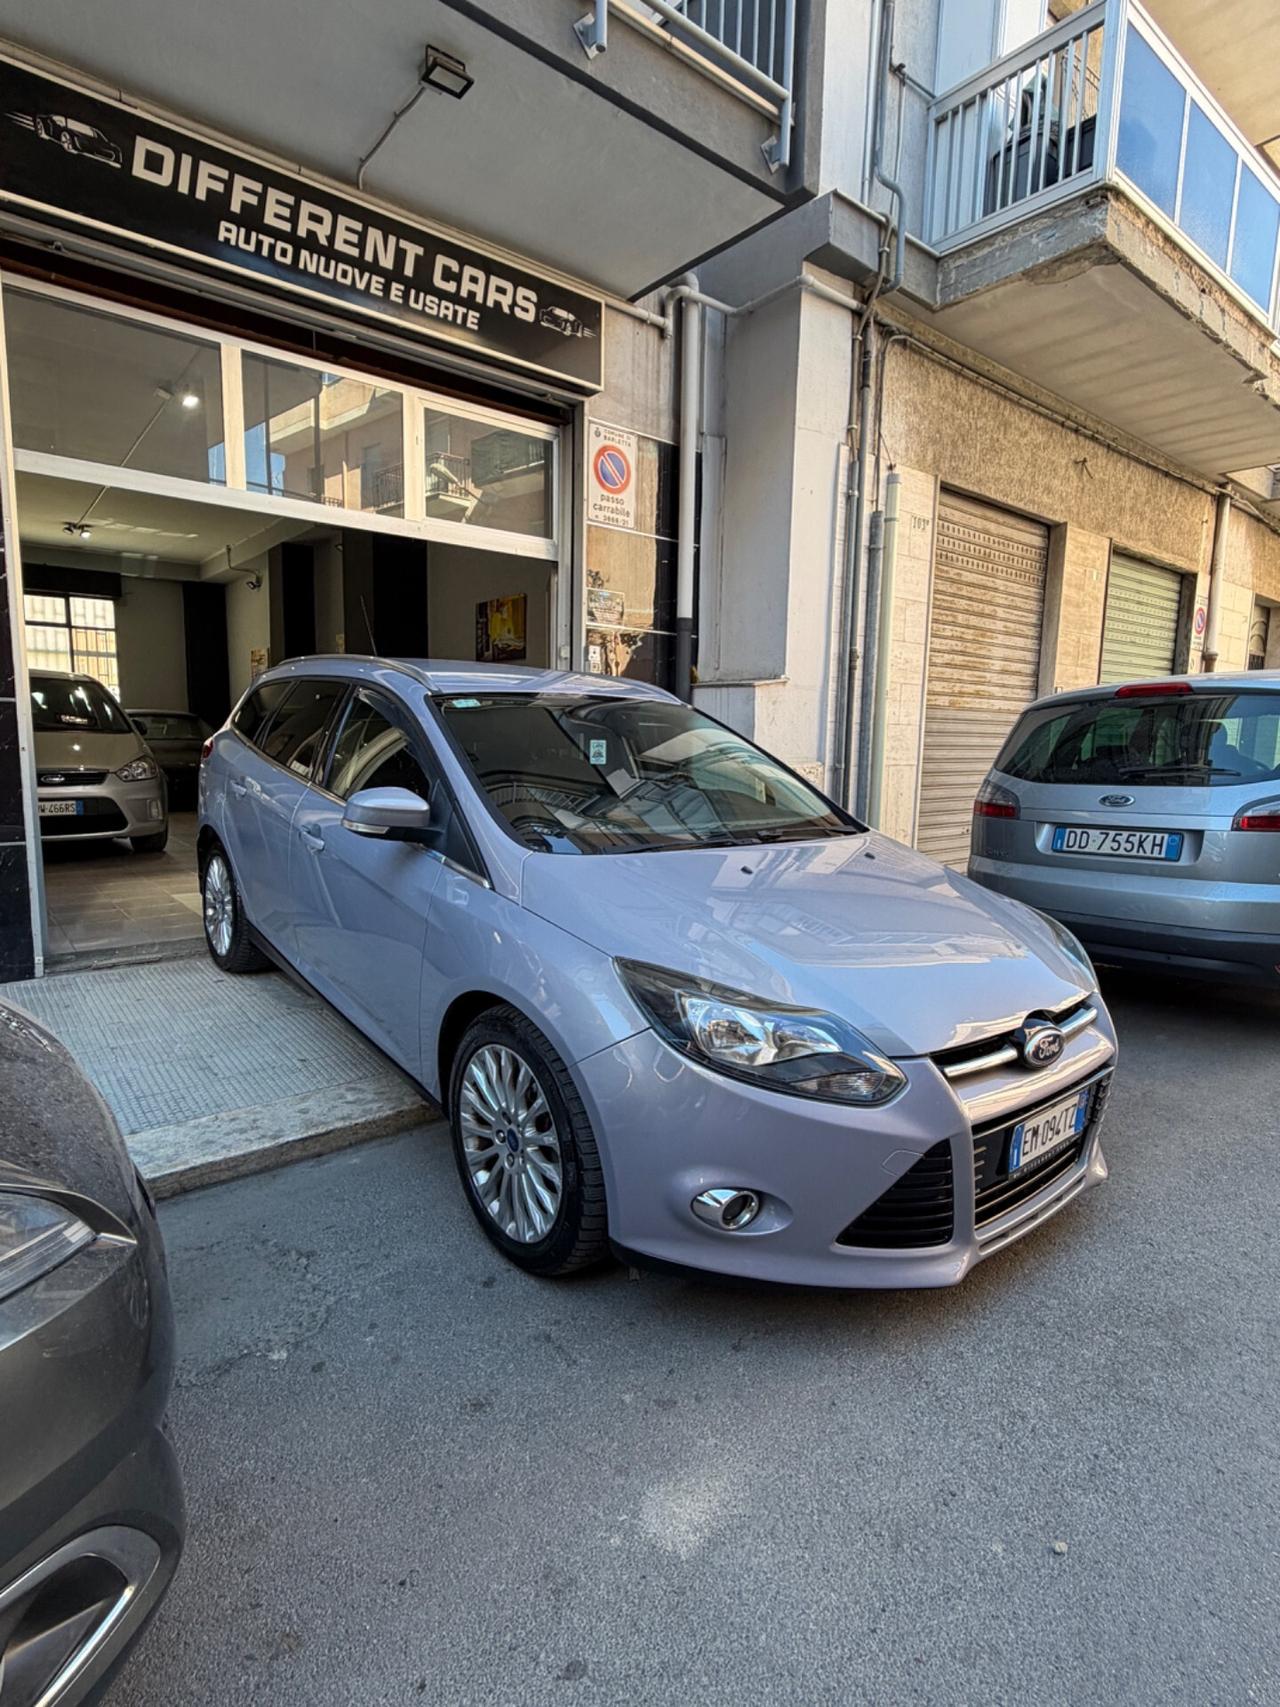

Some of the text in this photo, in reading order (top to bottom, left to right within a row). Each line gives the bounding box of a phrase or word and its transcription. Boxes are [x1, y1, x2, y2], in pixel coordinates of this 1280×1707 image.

[131, 135, 538, 323] DIFFERENT CARS
[217, 220, 481, 330] AUTO NUOVE E USATE
[592, 503, 631, 518] carrabile
[600, 494, 625, 506] passo
[48, 803, 76, 813] 466RS
[1066, 830, 1091, 849] DD
[1097, 831, 1165, 856] 755KH
[1022, 1124, 1040, 1156] EM
[1041, 1103, 1078, 1146] 094TZ
